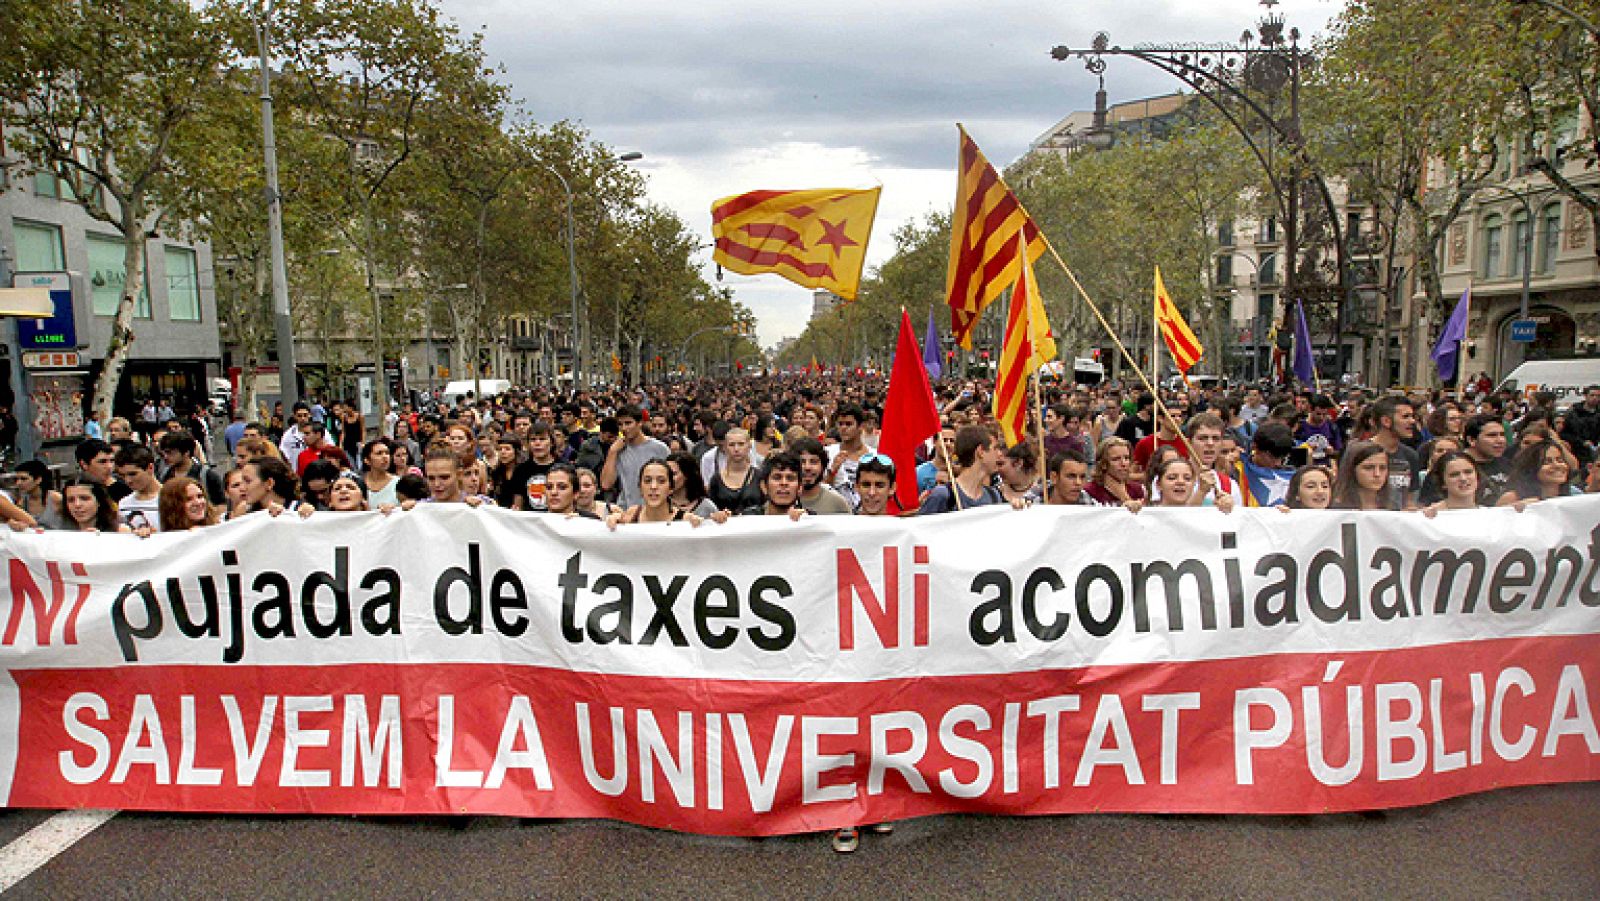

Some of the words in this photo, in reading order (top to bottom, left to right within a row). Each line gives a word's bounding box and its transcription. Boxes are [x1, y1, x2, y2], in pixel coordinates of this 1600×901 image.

[2, 558, 91, 646] Ni
[111, 546, 402, 664] pujada
[433, 542, 530, 638] de
[558, 550, 796, 652] taxes
[836, 545, 930, 652] Ni
[969, 523, 1600, 644] acomiadament
[58, 691, 402, 790] SALVEM
[434, 694, 553, 792] LA
[575, 691, 1200, 813] UNIVERSITAT
[1234, 660, 1600, 787] PÚBLICA
